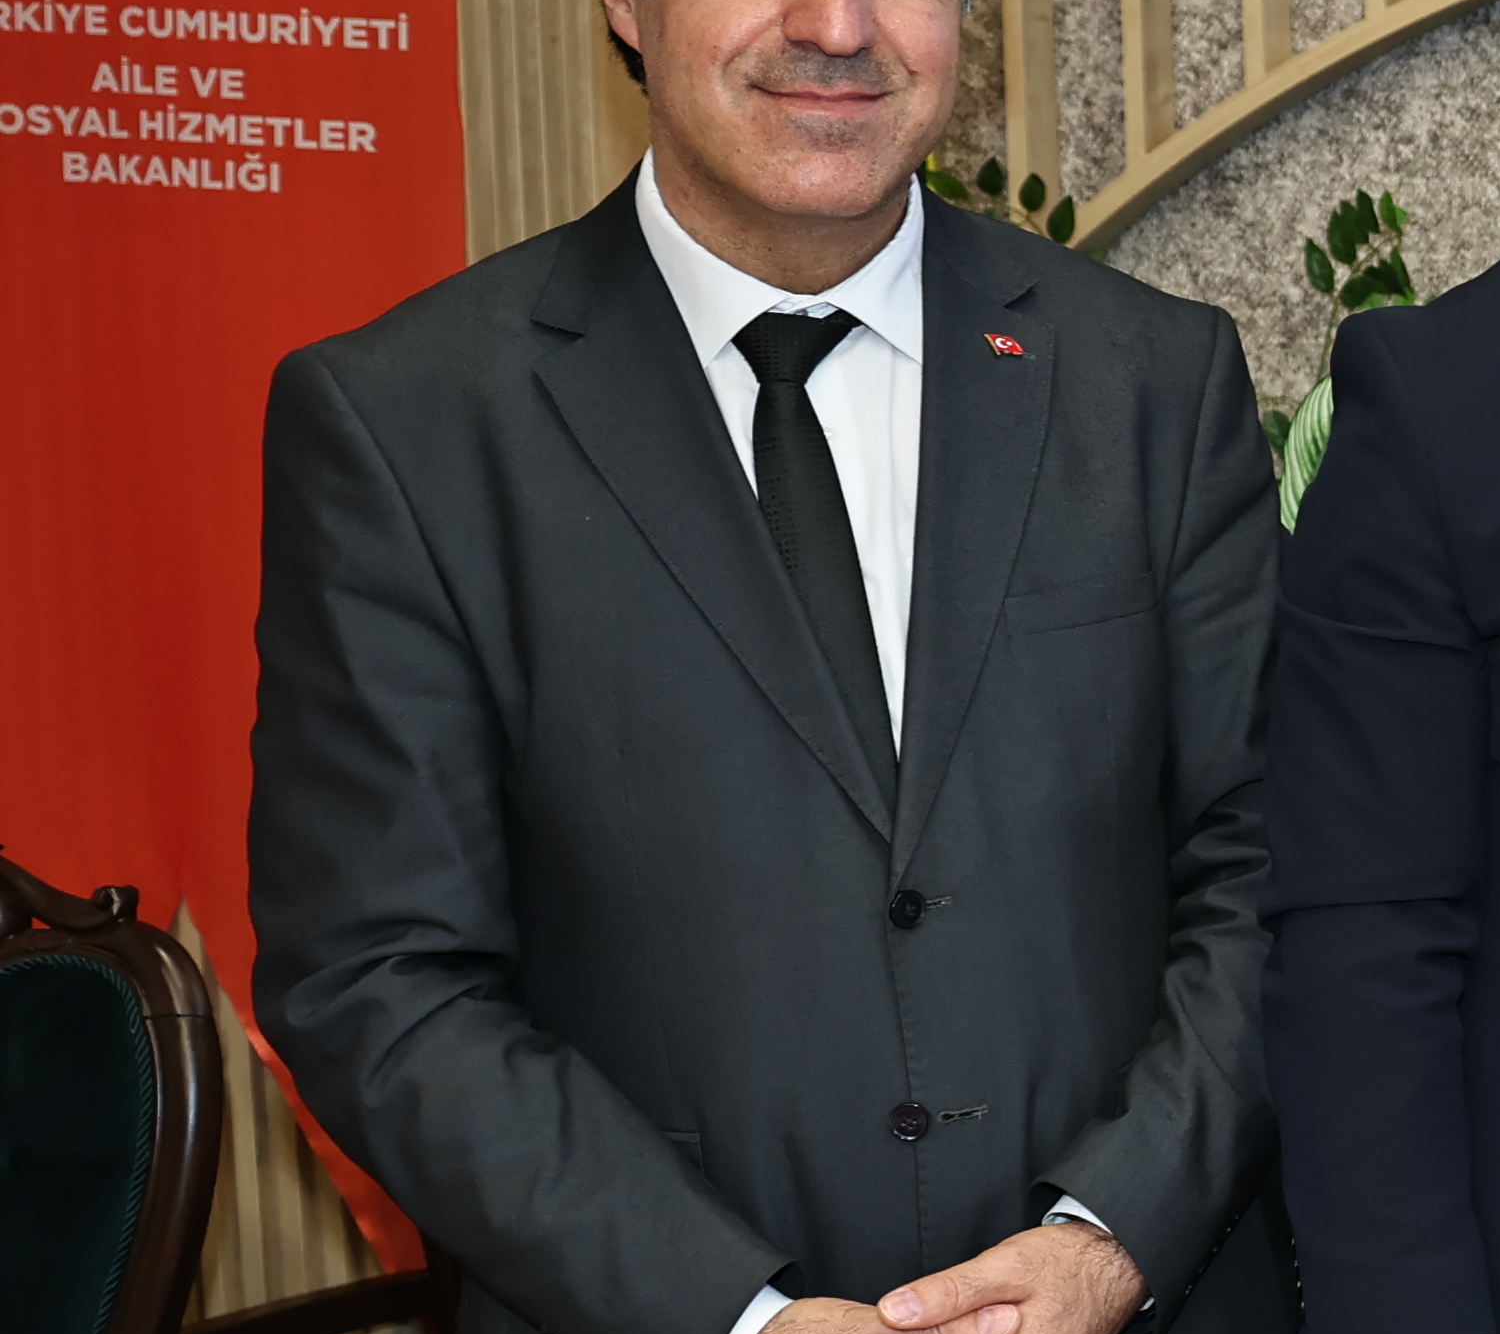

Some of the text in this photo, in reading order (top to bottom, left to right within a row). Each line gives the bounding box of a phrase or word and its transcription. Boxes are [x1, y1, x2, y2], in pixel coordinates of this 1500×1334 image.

[119, 7, 410, 52] CUMHURİYETİ
[91, 56, 246, 100] AİLE VE
[138, 103, 378, 154] HİZMETLER
[62, 151, 282, 194] BAKANLIĞI
